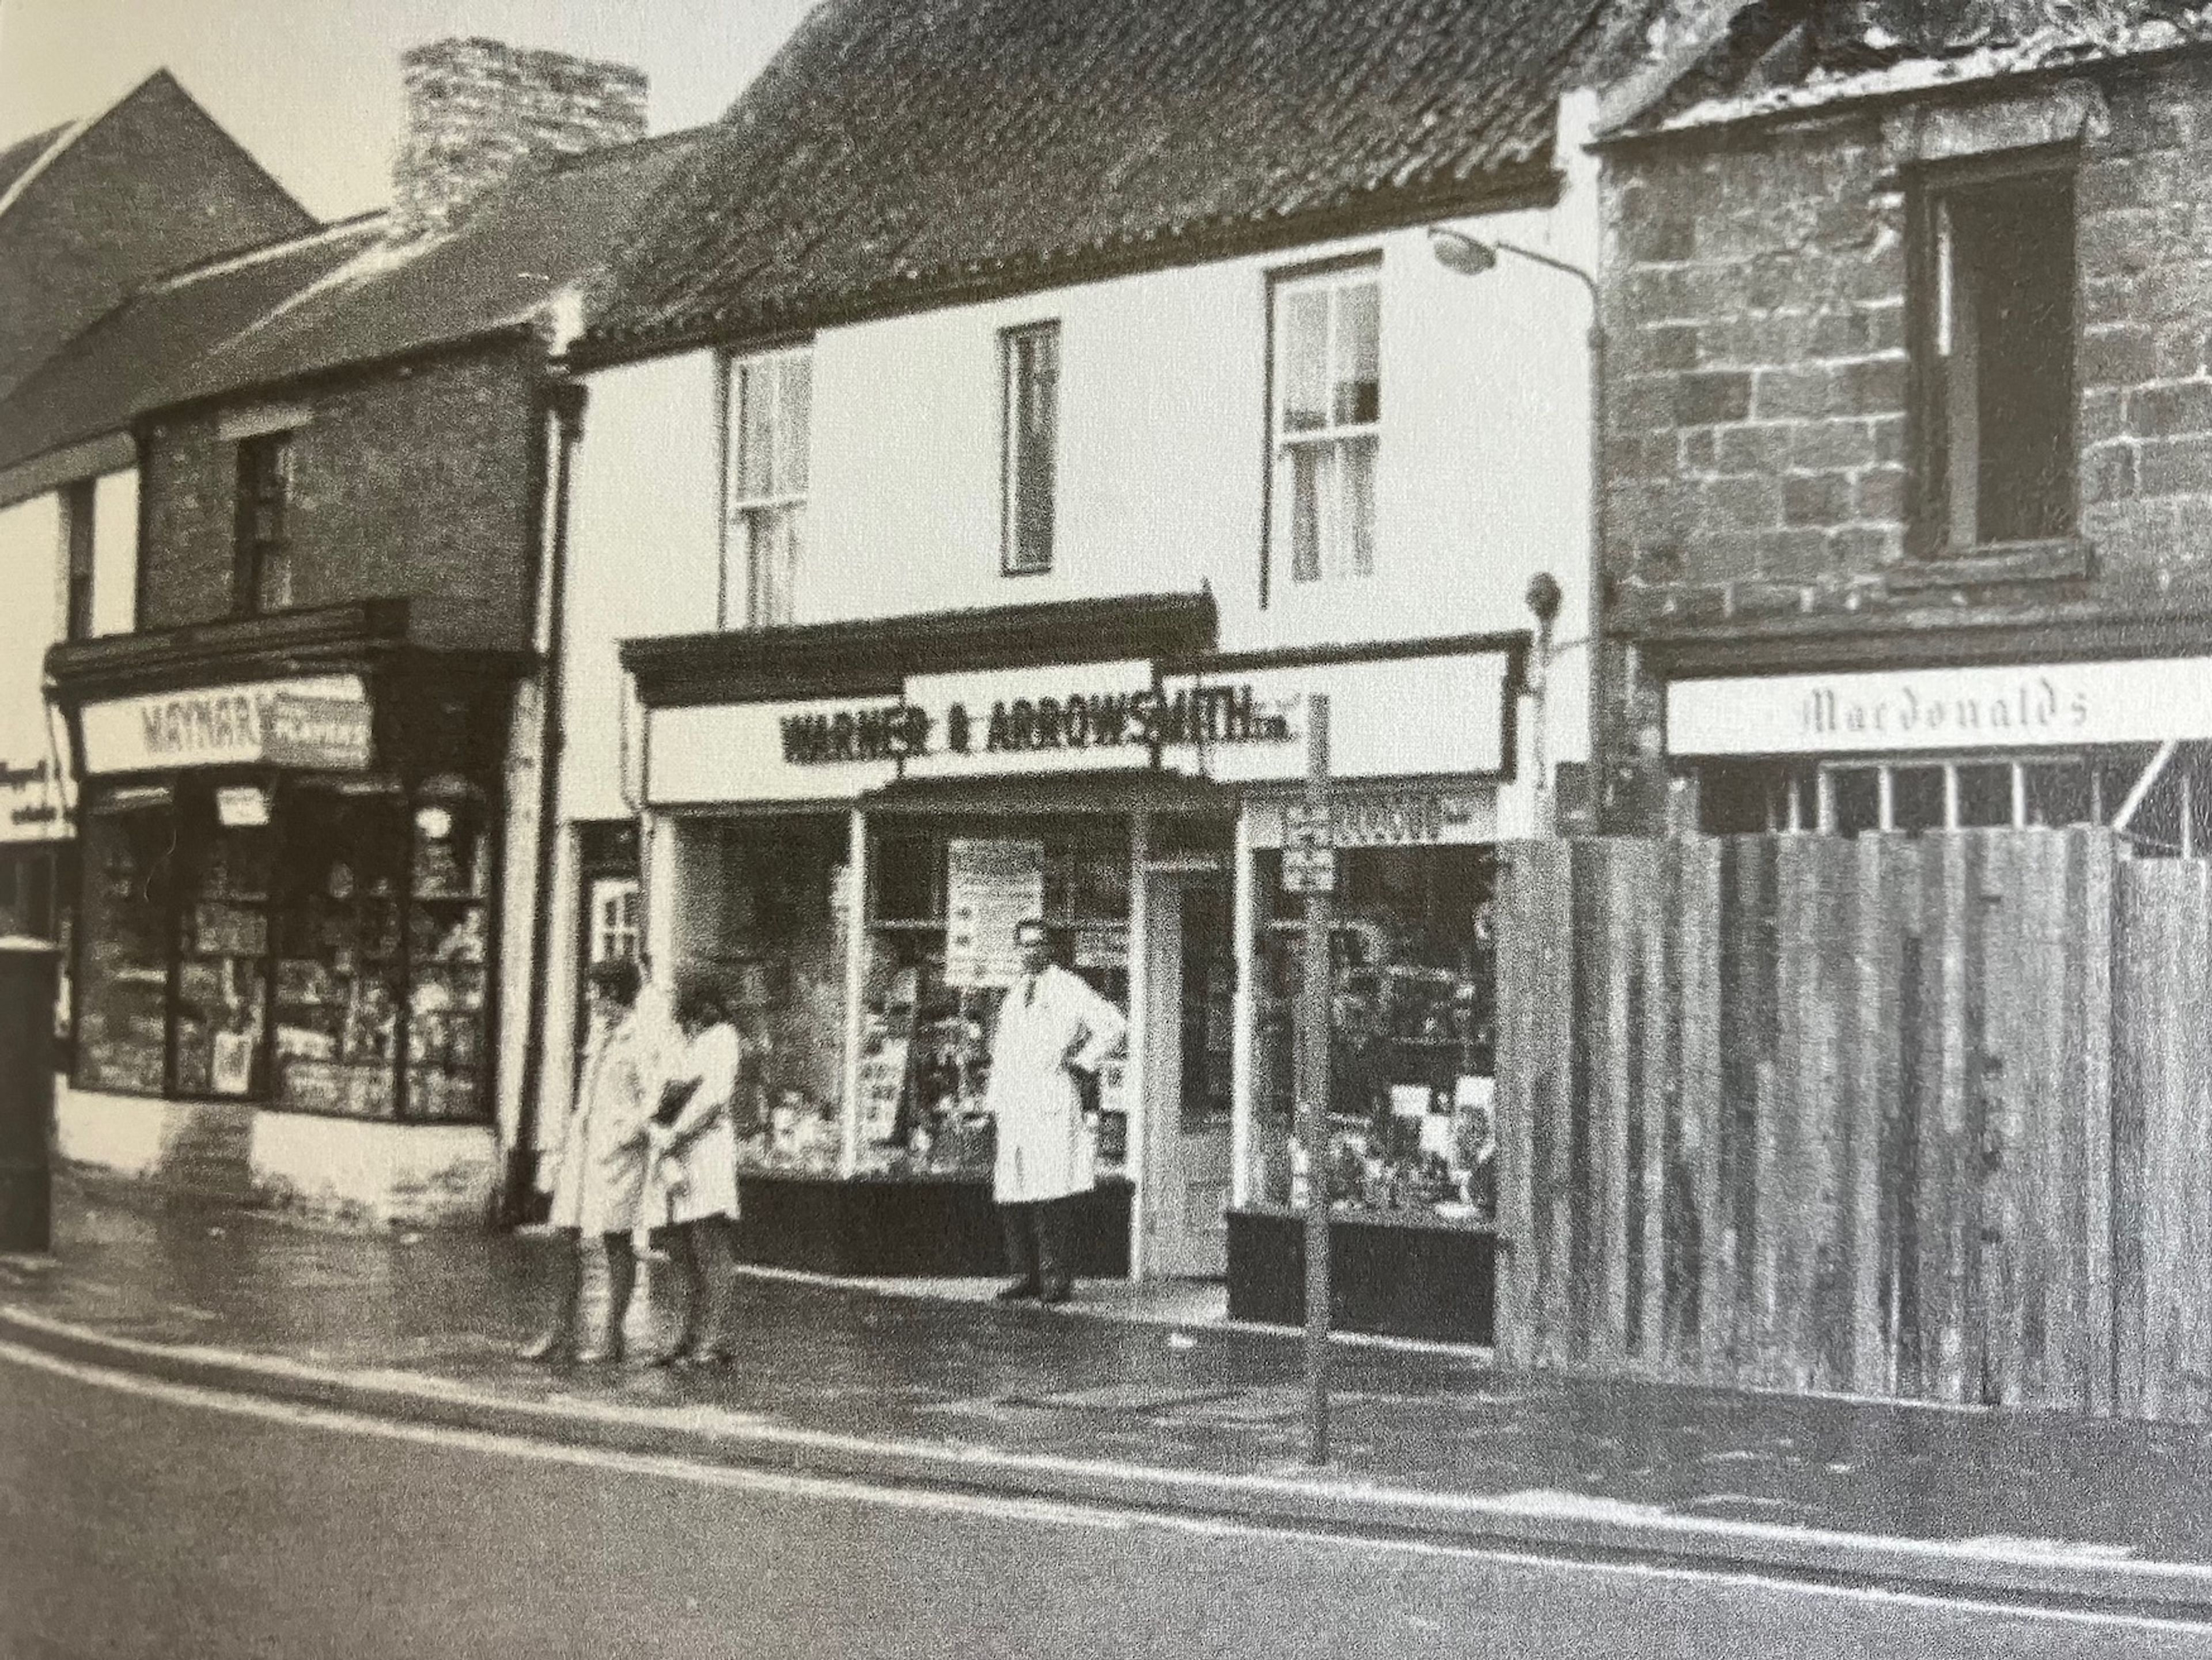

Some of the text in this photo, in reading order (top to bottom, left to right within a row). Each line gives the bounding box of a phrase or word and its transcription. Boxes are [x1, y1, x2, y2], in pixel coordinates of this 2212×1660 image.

[781, 704, 929, 765] WARNER
[986, 685, 1253, 753] ARROWSMITH
[1802, 676, 2088, 734] Macdonalds
